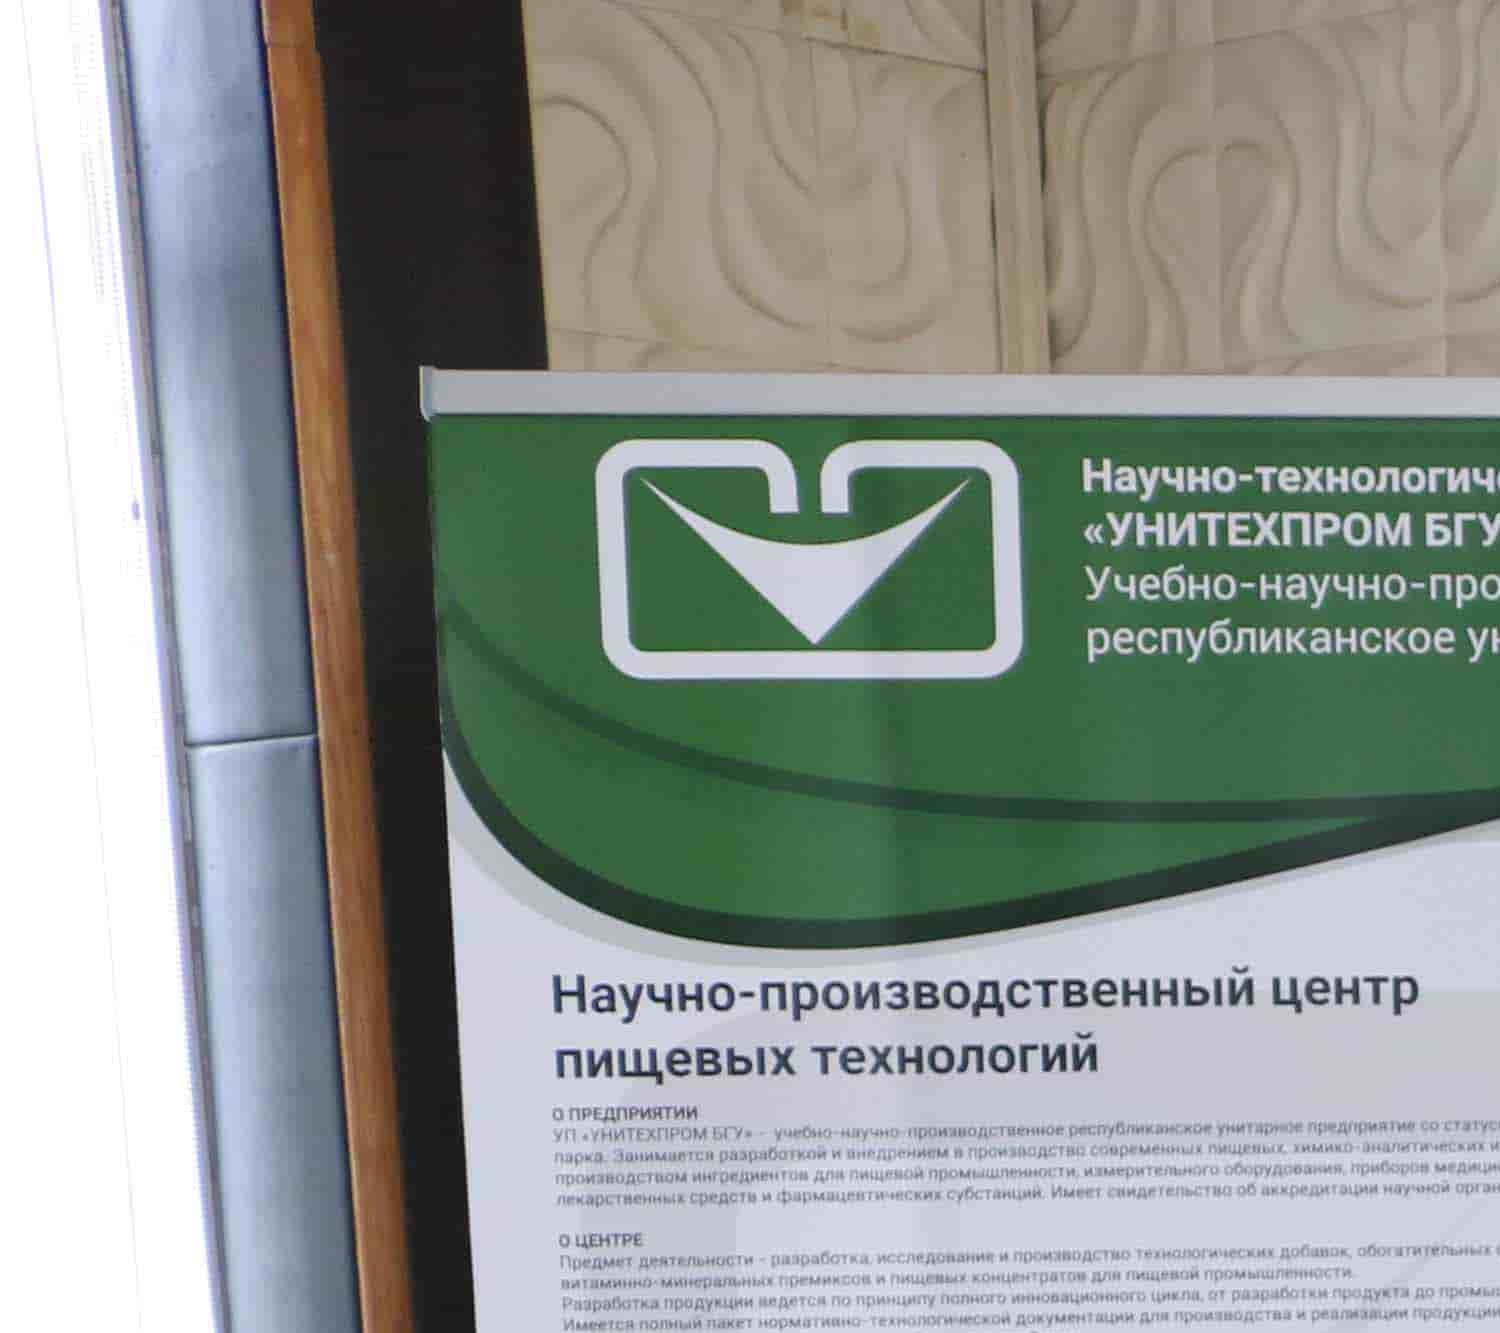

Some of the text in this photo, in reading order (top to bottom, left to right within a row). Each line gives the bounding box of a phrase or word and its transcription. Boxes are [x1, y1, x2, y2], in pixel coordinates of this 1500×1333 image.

[1085, 512, 1410, 547] «УНИТЕХПРОМ
[1088, 618, 1455, 663] республиканское
[553, 968, 1420, 1024] Научно-производственный центр
[556, 1032, 1099, 1085] пищевых технологий
[567, 1105, 699, 1122] ПРЕДПРИЯТИИ
[575, 1232, 644, 1249] ЦЕНТРЕ
